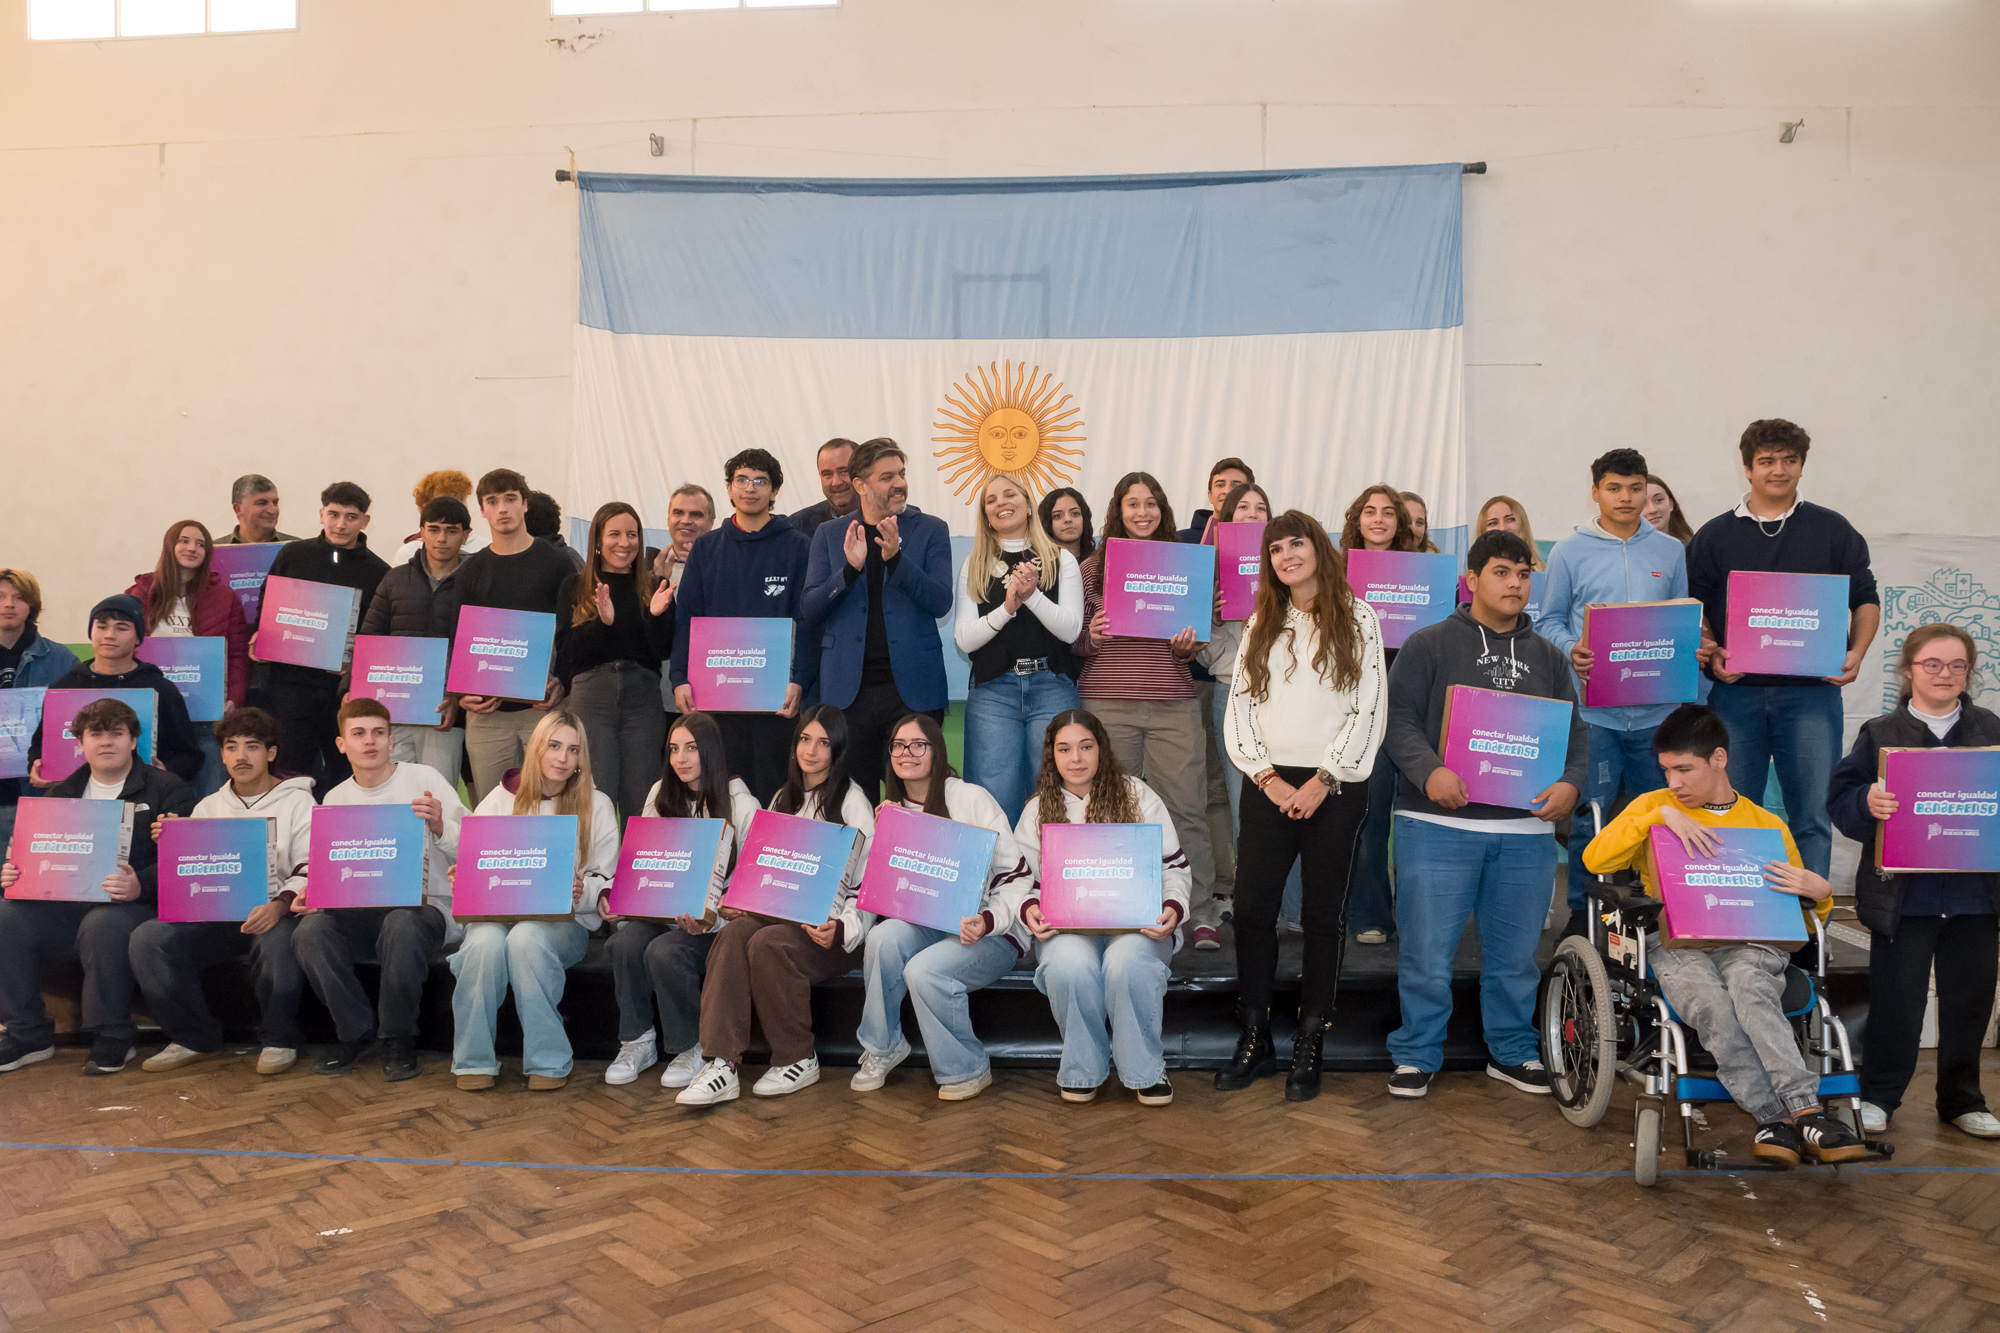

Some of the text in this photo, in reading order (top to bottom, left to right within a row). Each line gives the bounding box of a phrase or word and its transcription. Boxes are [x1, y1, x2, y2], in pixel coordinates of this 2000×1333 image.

[1158, 574, 1188, 582] igualdad
[1399, 584, 1429, 592] igualdad
[1785, 608, 1818, 616] igualdad
[502, 638, 528, 646] igualdad
[1643, 639, 1674, 648] igualdad
[1476, 656, 1530, 674] NEW YORK
[1492, 677, 1516, 686] CITY
[1472, 730, 1539, 744] conectar igualdad
[1958, 791, 1998, 800] igualdad
[64, 832, 94, 840] igualdad
[364, 838, 396, 847] igualdad
[514, 848, 546, 856] igualdad
[664, 850, 692, 858] igualdad
[762, 846, 821, 862] conectar igualdad
[210, 852, 240, 862] igualdad
[894, 846, 960, 868] conectar igualdad
[1100, 858, 1132, 866] igualdad
[1722, 864, 1759, 872] igualdad
